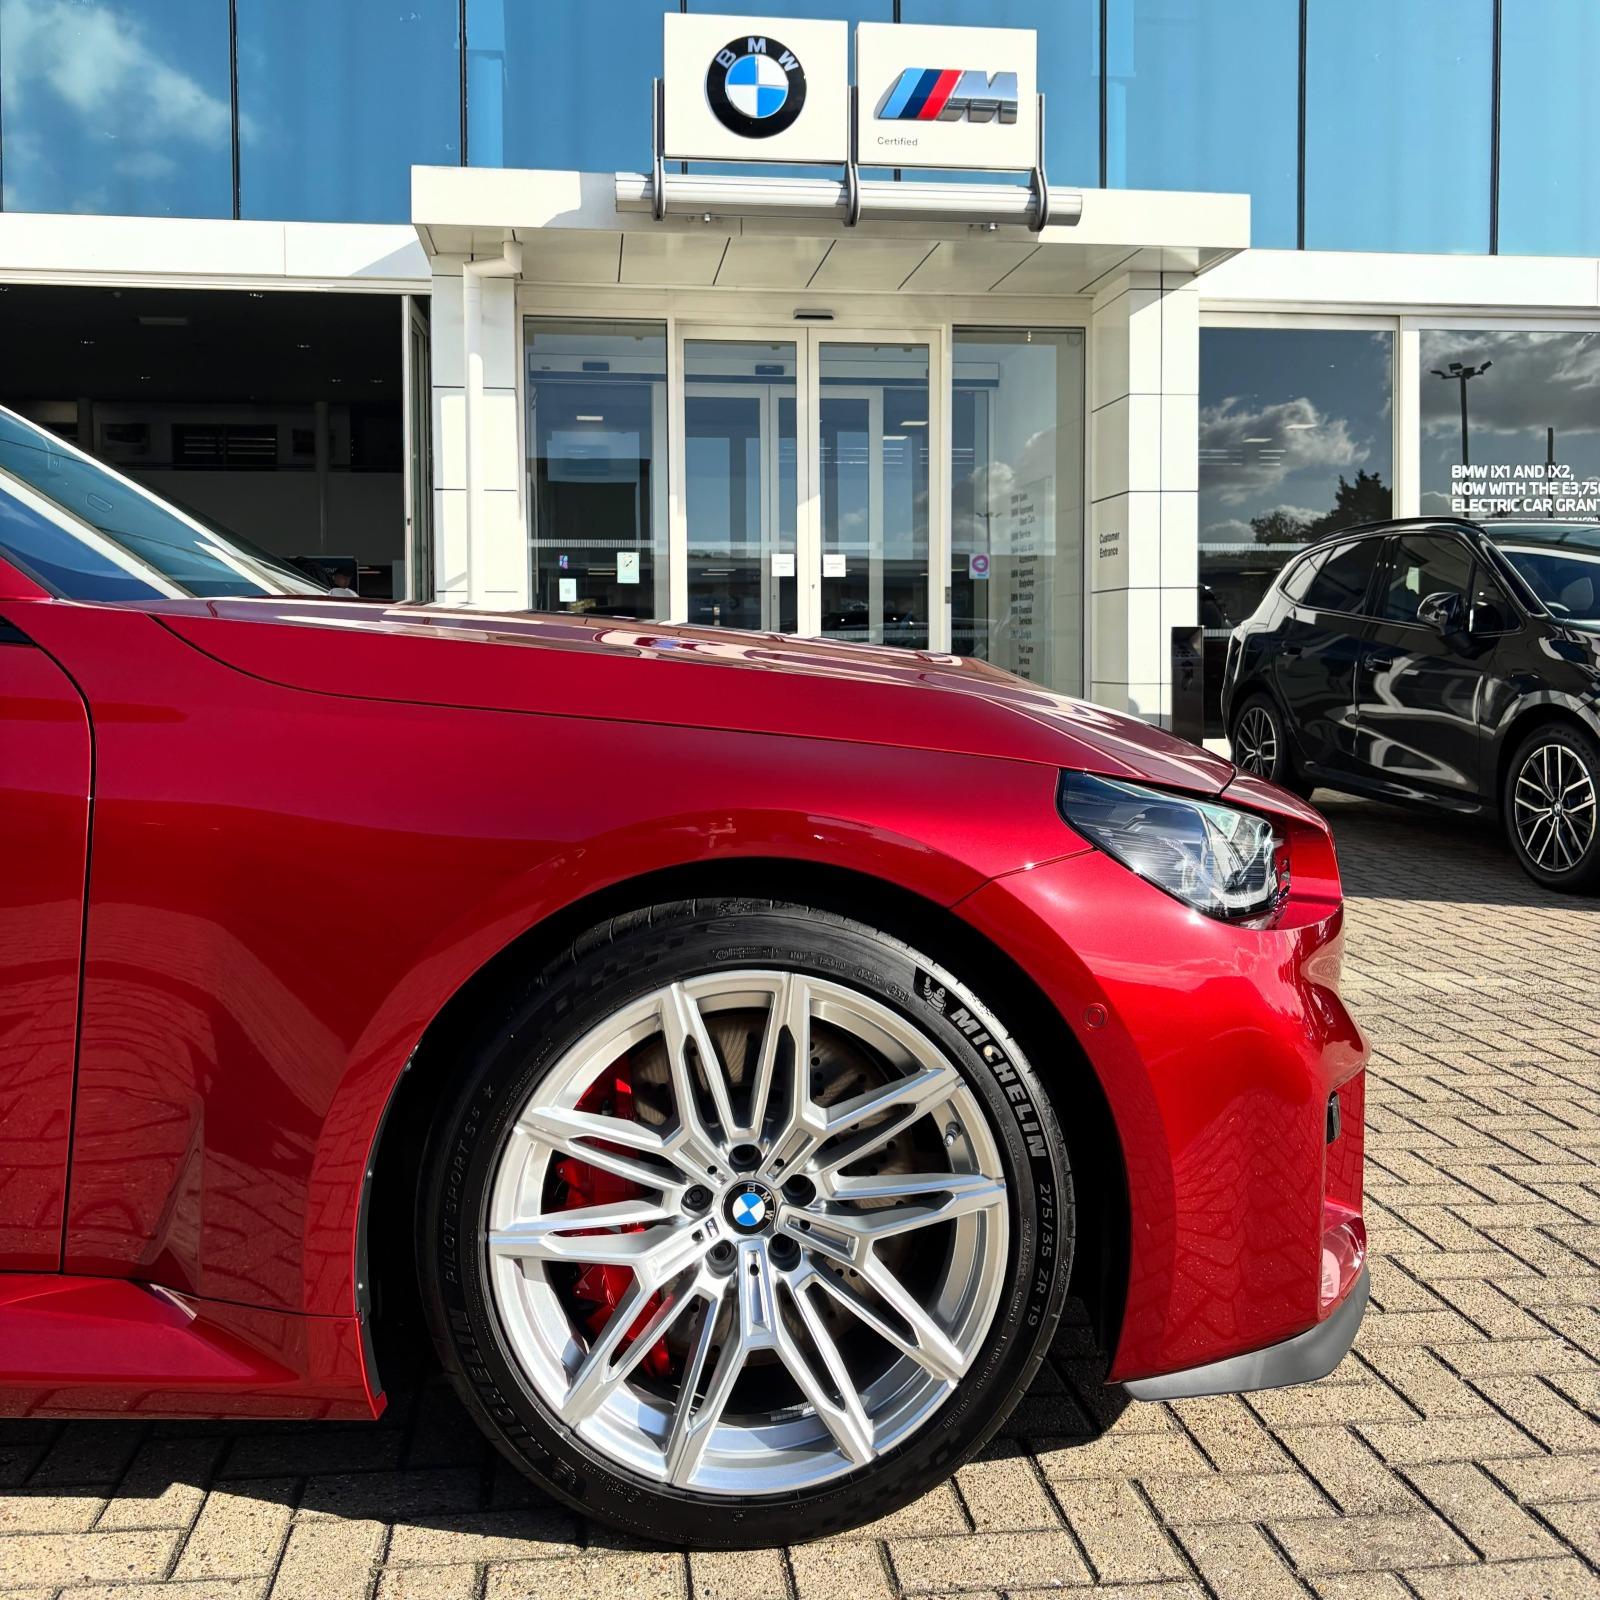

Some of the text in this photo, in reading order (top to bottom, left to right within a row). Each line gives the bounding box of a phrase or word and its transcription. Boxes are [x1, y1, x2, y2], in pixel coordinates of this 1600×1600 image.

[715, 37, 800, 72] BMW
[877, 136, 918, 147] Certified
[1451, 465, 1487, 478] BMW
[1513, 465, 1545, 478] AND
[1452, 482, 1486, 495] NOW
[1489, 482, 1526, 495] WITH
[1529, 482, 1558, 495] THE
[1452, 499, 1520, 512] ELECTRIC
[1523, 499, 1552, 512] CAR
[1100, 532, 1119, 544] Customer
[1100, 548, 1118, 558] Entrance
[950, 1007, 1047, 1157] MICHELIN
[446, 1140, 469, 1215] SPORT
[747, 1183, 774, 1221] BMW
[443, 1219, 458, 1284] PILOT
[1027, 1183, 1053, 1326] 275/35 ZR 19
